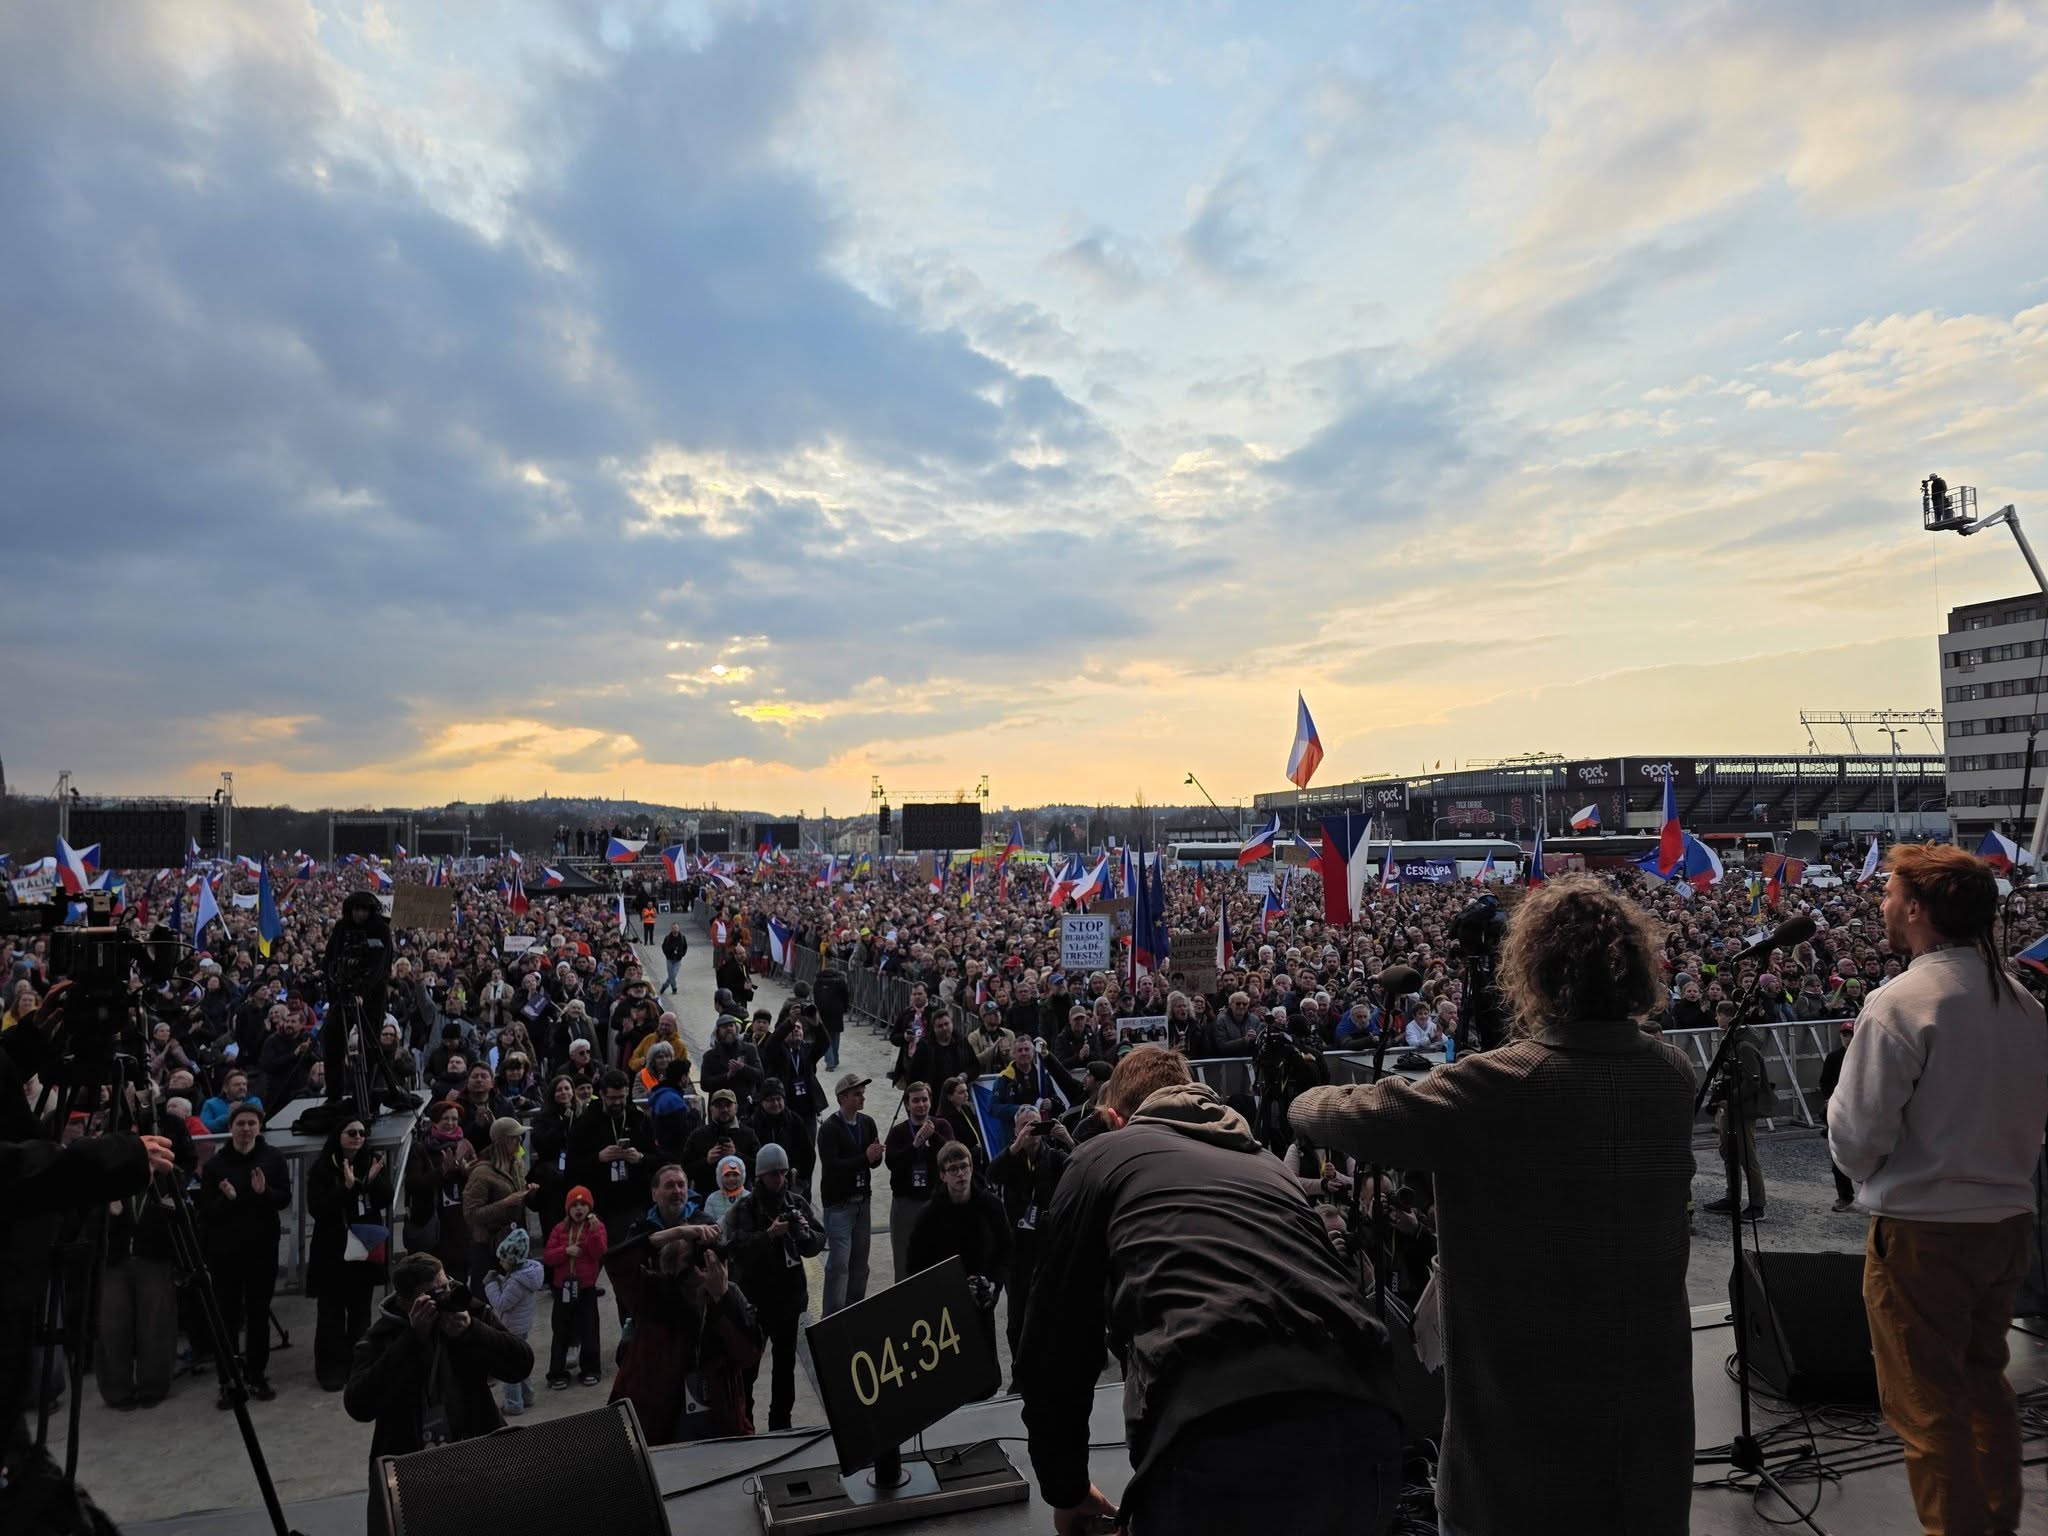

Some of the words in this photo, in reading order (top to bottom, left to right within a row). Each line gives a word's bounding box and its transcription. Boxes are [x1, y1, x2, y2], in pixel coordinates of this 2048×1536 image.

[1068, 920, 1104, 932] STOP
[1172, 937, 1214, 948] LIBEREC
[1171, 949, 1215, 960] NECHCE
[850, 1306, 961, 1406] 04:34
